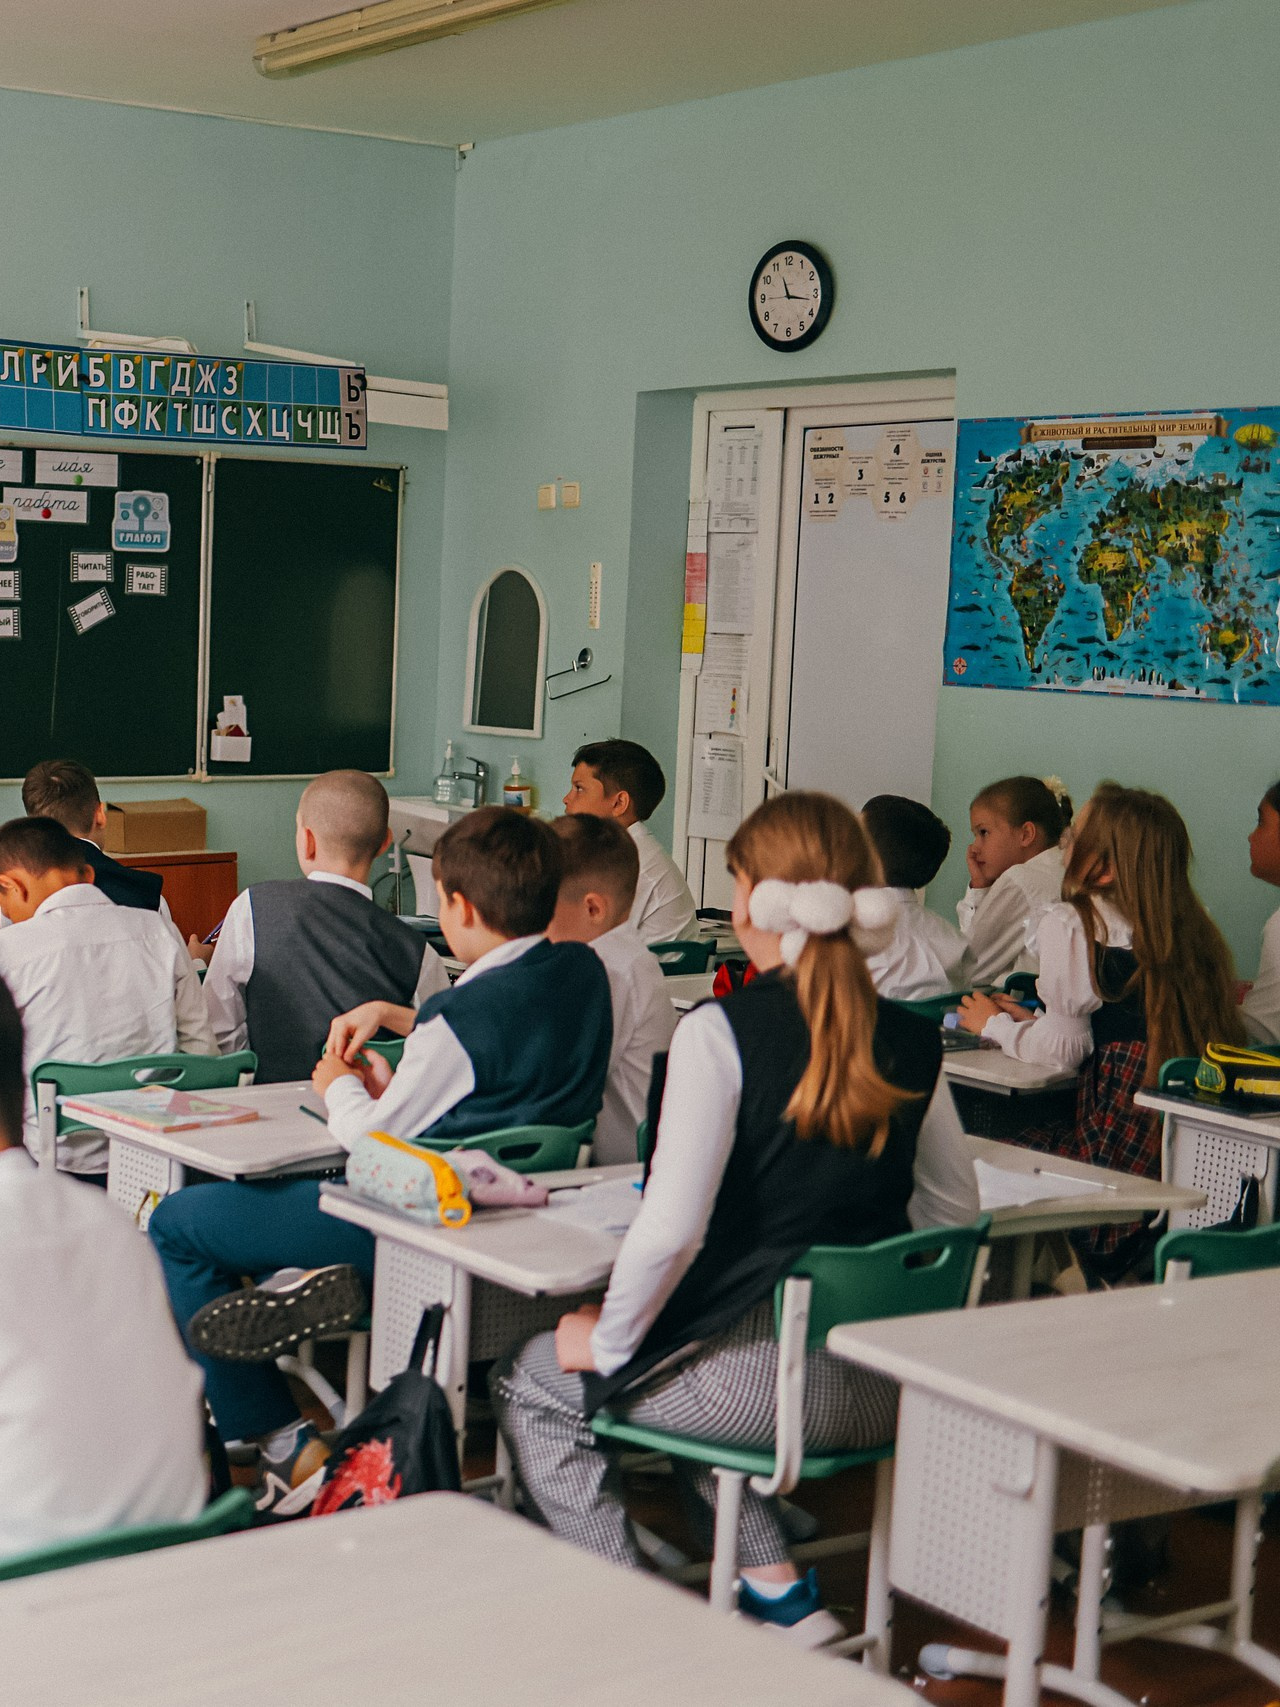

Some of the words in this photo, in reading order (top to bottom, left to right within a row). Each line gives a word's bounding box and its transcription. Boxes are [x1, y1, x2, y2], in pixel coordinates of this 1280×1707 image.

[784, 256, 794, 266] 12
[800, 260, 804, 269] 1
[773, 263, 779, 272] 11
[763, 275, 771, 285] 10
[809, 271, 815, 281] 2
[761, 294, 766, 303] 9
[813, 289, 818, 298] 3
[764, 312, 769, 321] 8
[808, 308, 814, 317] 4
[773, 324, 778, 333] 7
[799, 322, 804, 331] 5
[786, 327, 791, 337] 6
[1039, 427, 1084, 437] ЖИВОТНЫЙ
[1086, 427, 1091, 435] И
[1093, 424, 1156, 434] РАСТИТЕЛЬНЫЙ
[1158, 424, 1176, 432] МИР
[1179, 423, 1207, 431] ЗЕМЛИ
[894, 444, 900, 455] 4
[857, 469, 863, 480] 3
[814, 493, 819, 504] 1
[828, 493, 834, 504] 2
[884, 492, 890, 503] 5
[899, 492, 906, 503] 6
[120, 533, 161, 543] ГЛАГОЛ
[79, 563, 107, 571] ЧИТАТЬ
